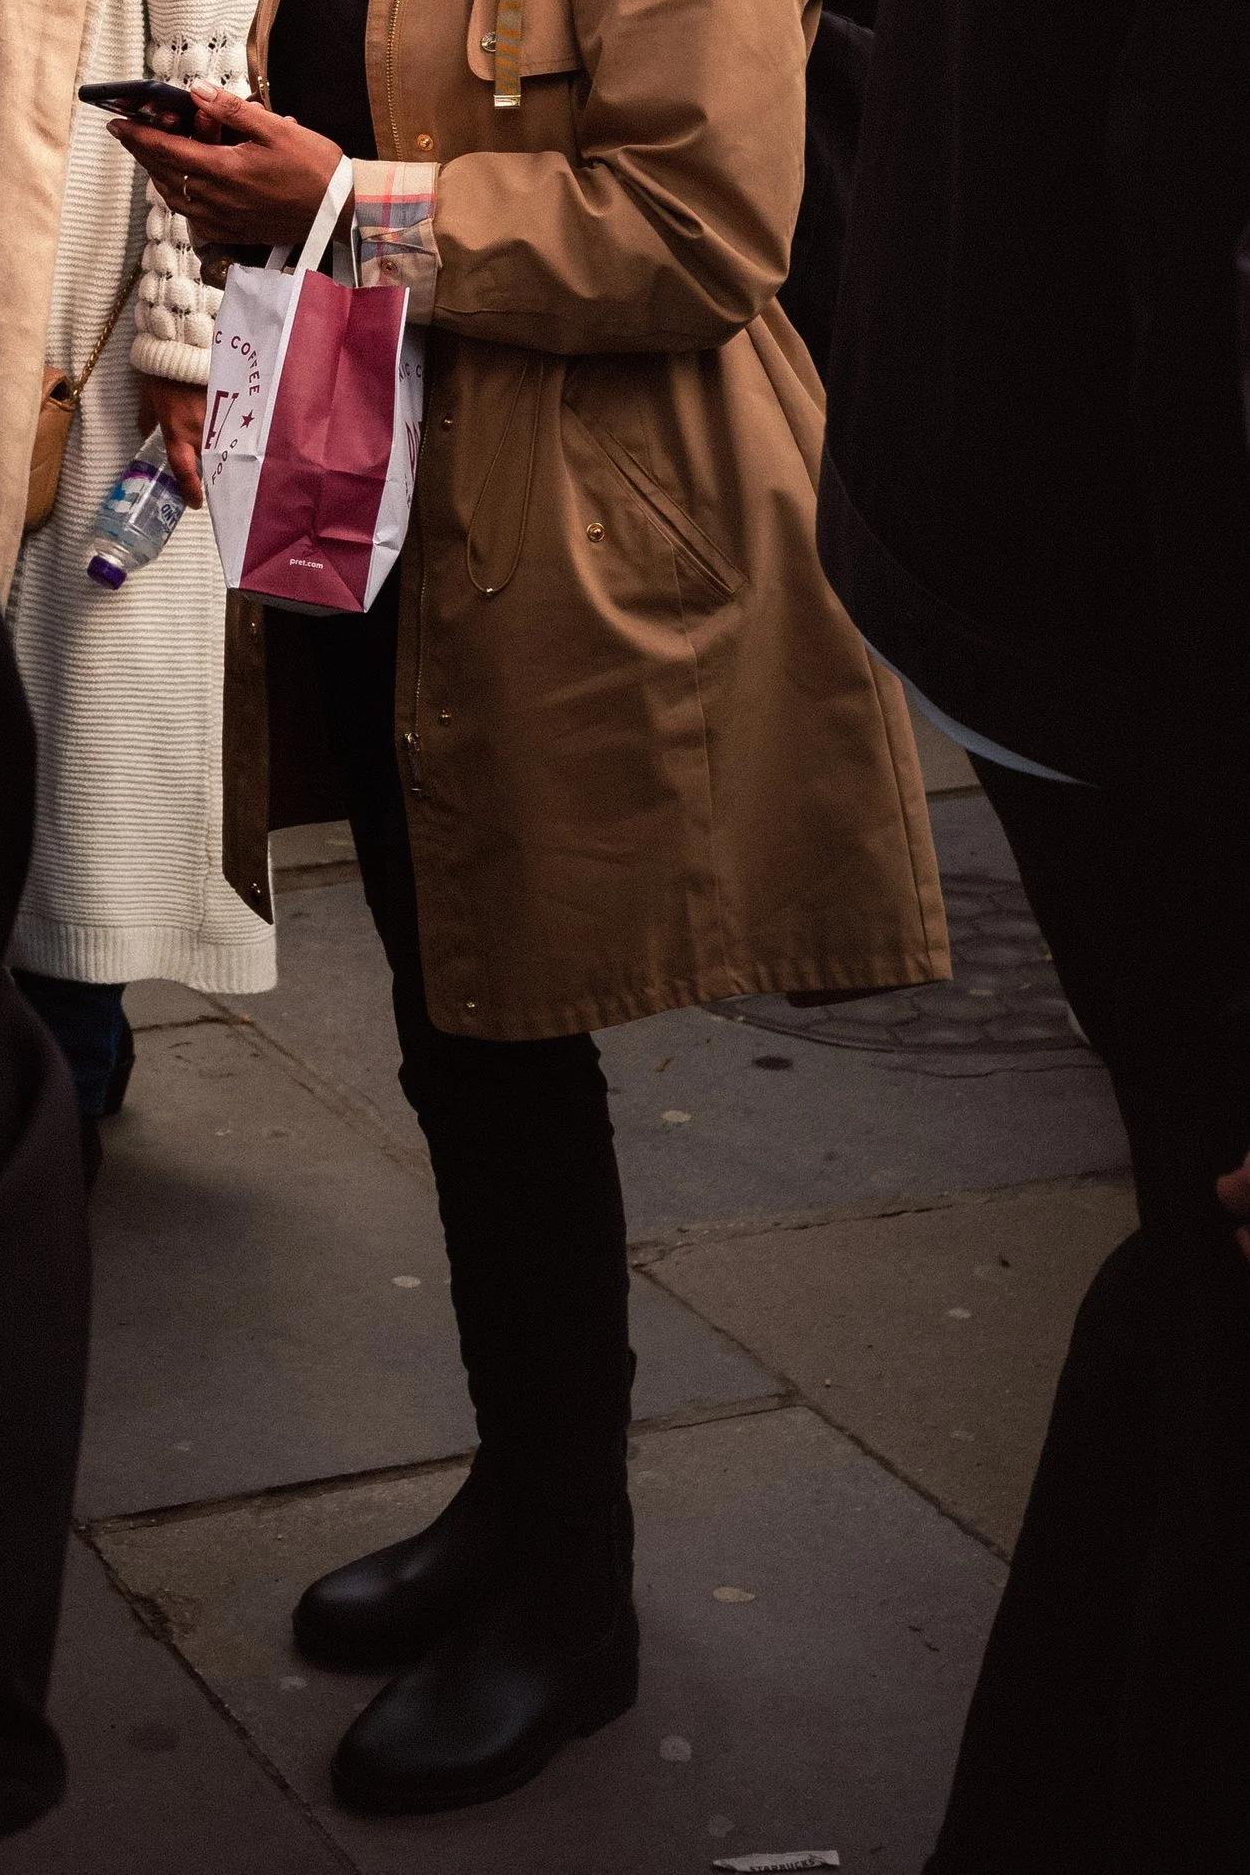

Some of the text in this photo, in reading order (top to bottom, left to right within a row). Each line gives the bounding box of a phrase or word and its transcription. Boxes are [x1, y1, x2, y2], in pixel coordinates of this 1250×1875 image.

[231, 335, 260, 397] COFFEE
[211, 438, 238, 486] FOOD
[290, 558, 323, 569] pret.com
